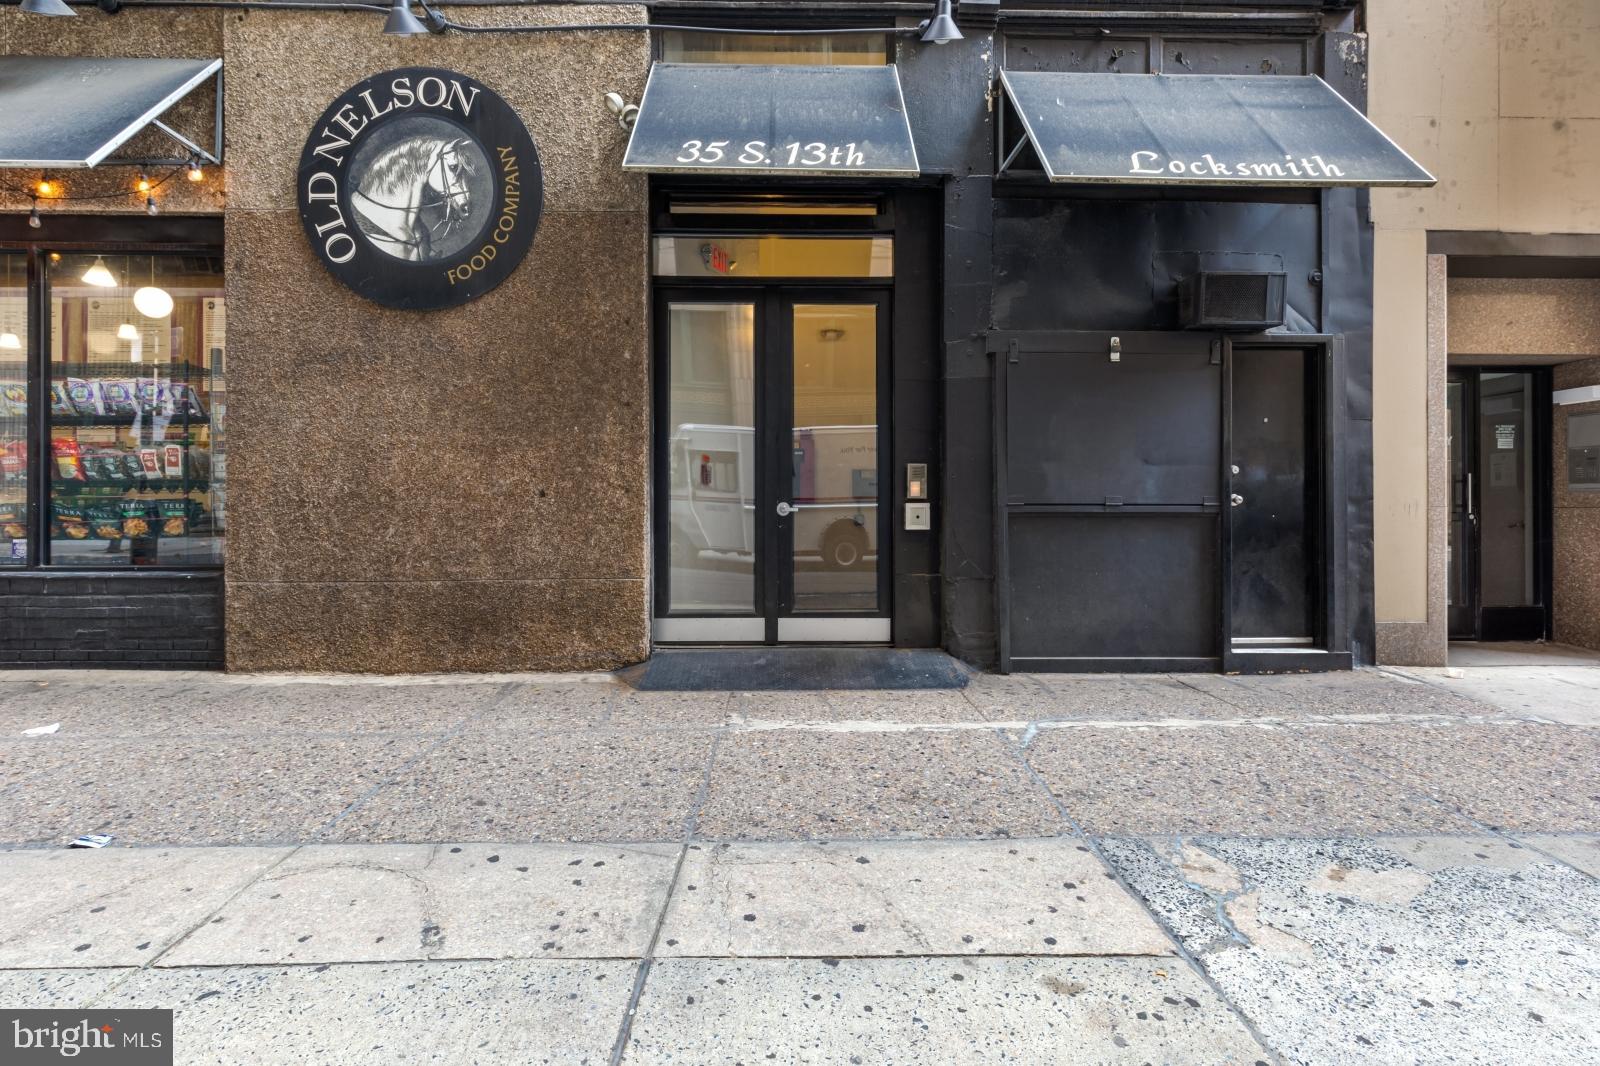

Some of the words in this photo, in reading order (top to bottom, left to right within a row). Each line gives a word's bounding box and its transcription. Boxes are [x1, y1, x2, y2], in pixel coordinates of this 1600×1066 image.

[312, 76, 480, 167] NELSON
[676, 140, 729, 163] 35
[738, 141, 771, 164] S.
[785, 142, 865, 166] 13th
[1129, 150, 1345, 178] Locksmith
[308, 171, 356, 264] OLD
[447, 245, 497, 285] FOOD
[493, 146, 520, 244] COMPANY
